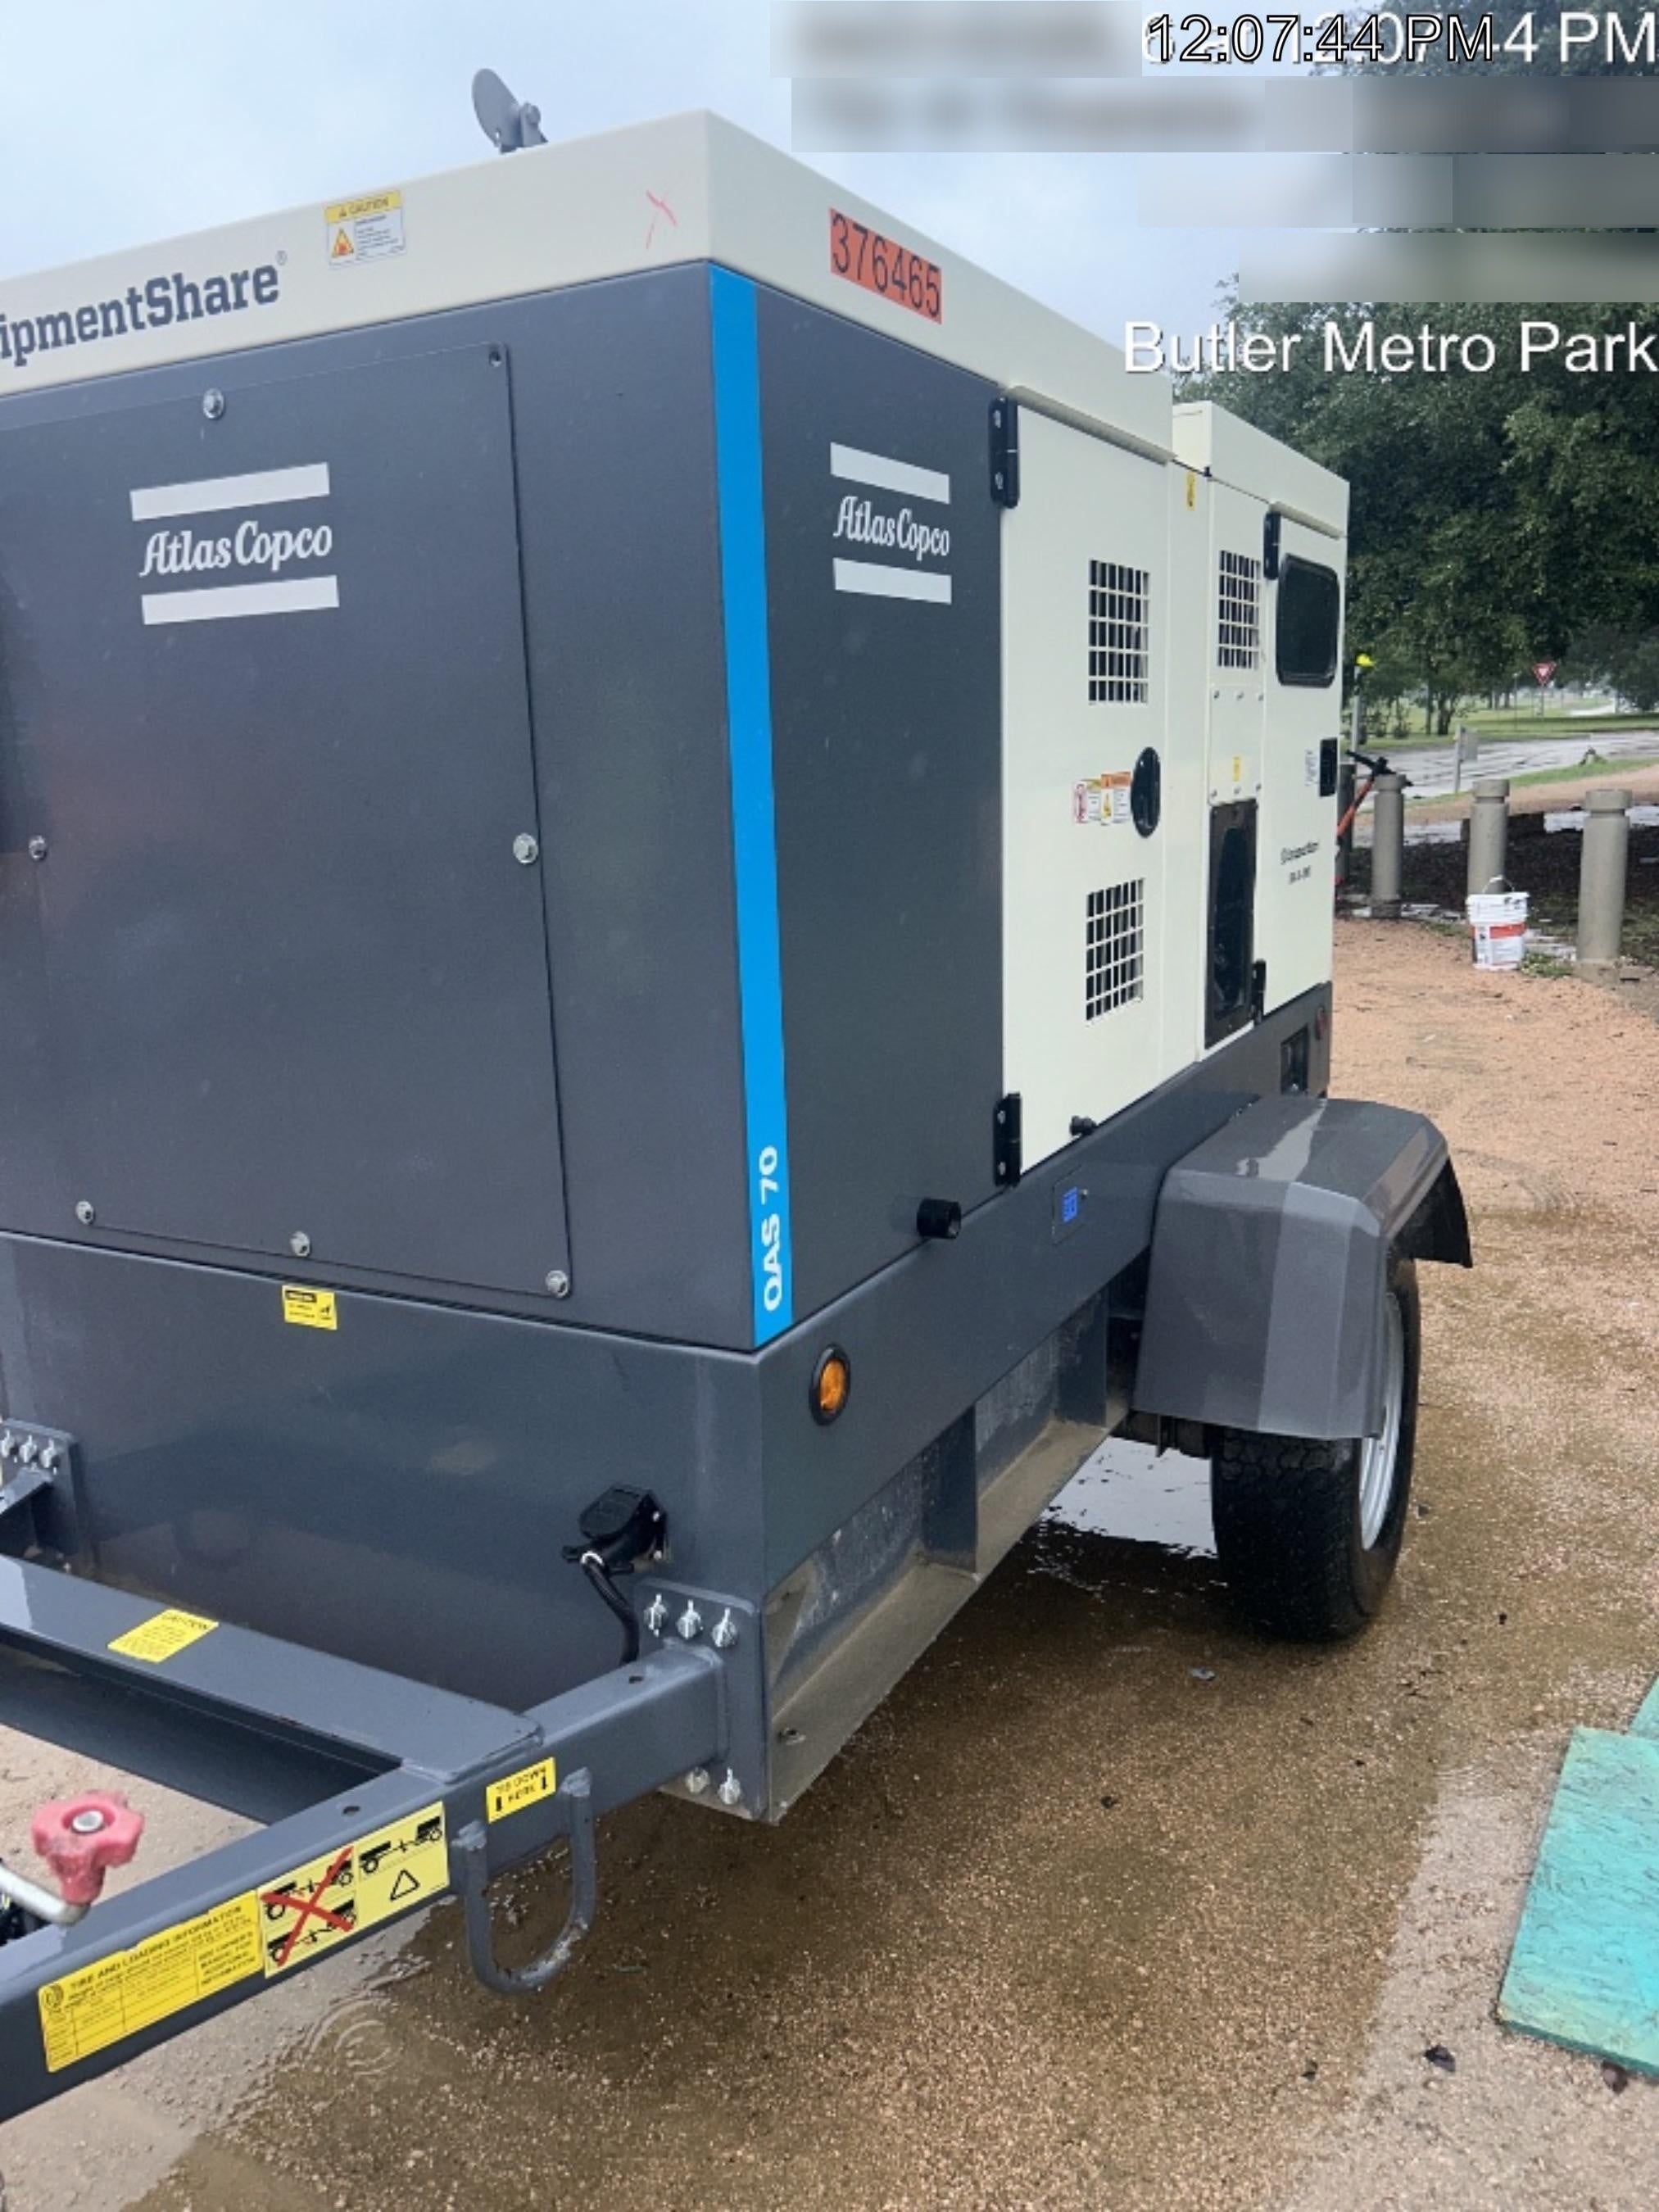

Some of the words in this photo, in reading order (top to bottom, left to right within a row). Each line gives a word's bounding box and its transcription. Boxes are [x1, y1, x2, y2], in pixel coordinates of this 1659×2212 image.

[832, 212, 941, 318] 376465
[758, 1145, 778, 1206] 70
[760, 1213, 783, 1312] QAS
